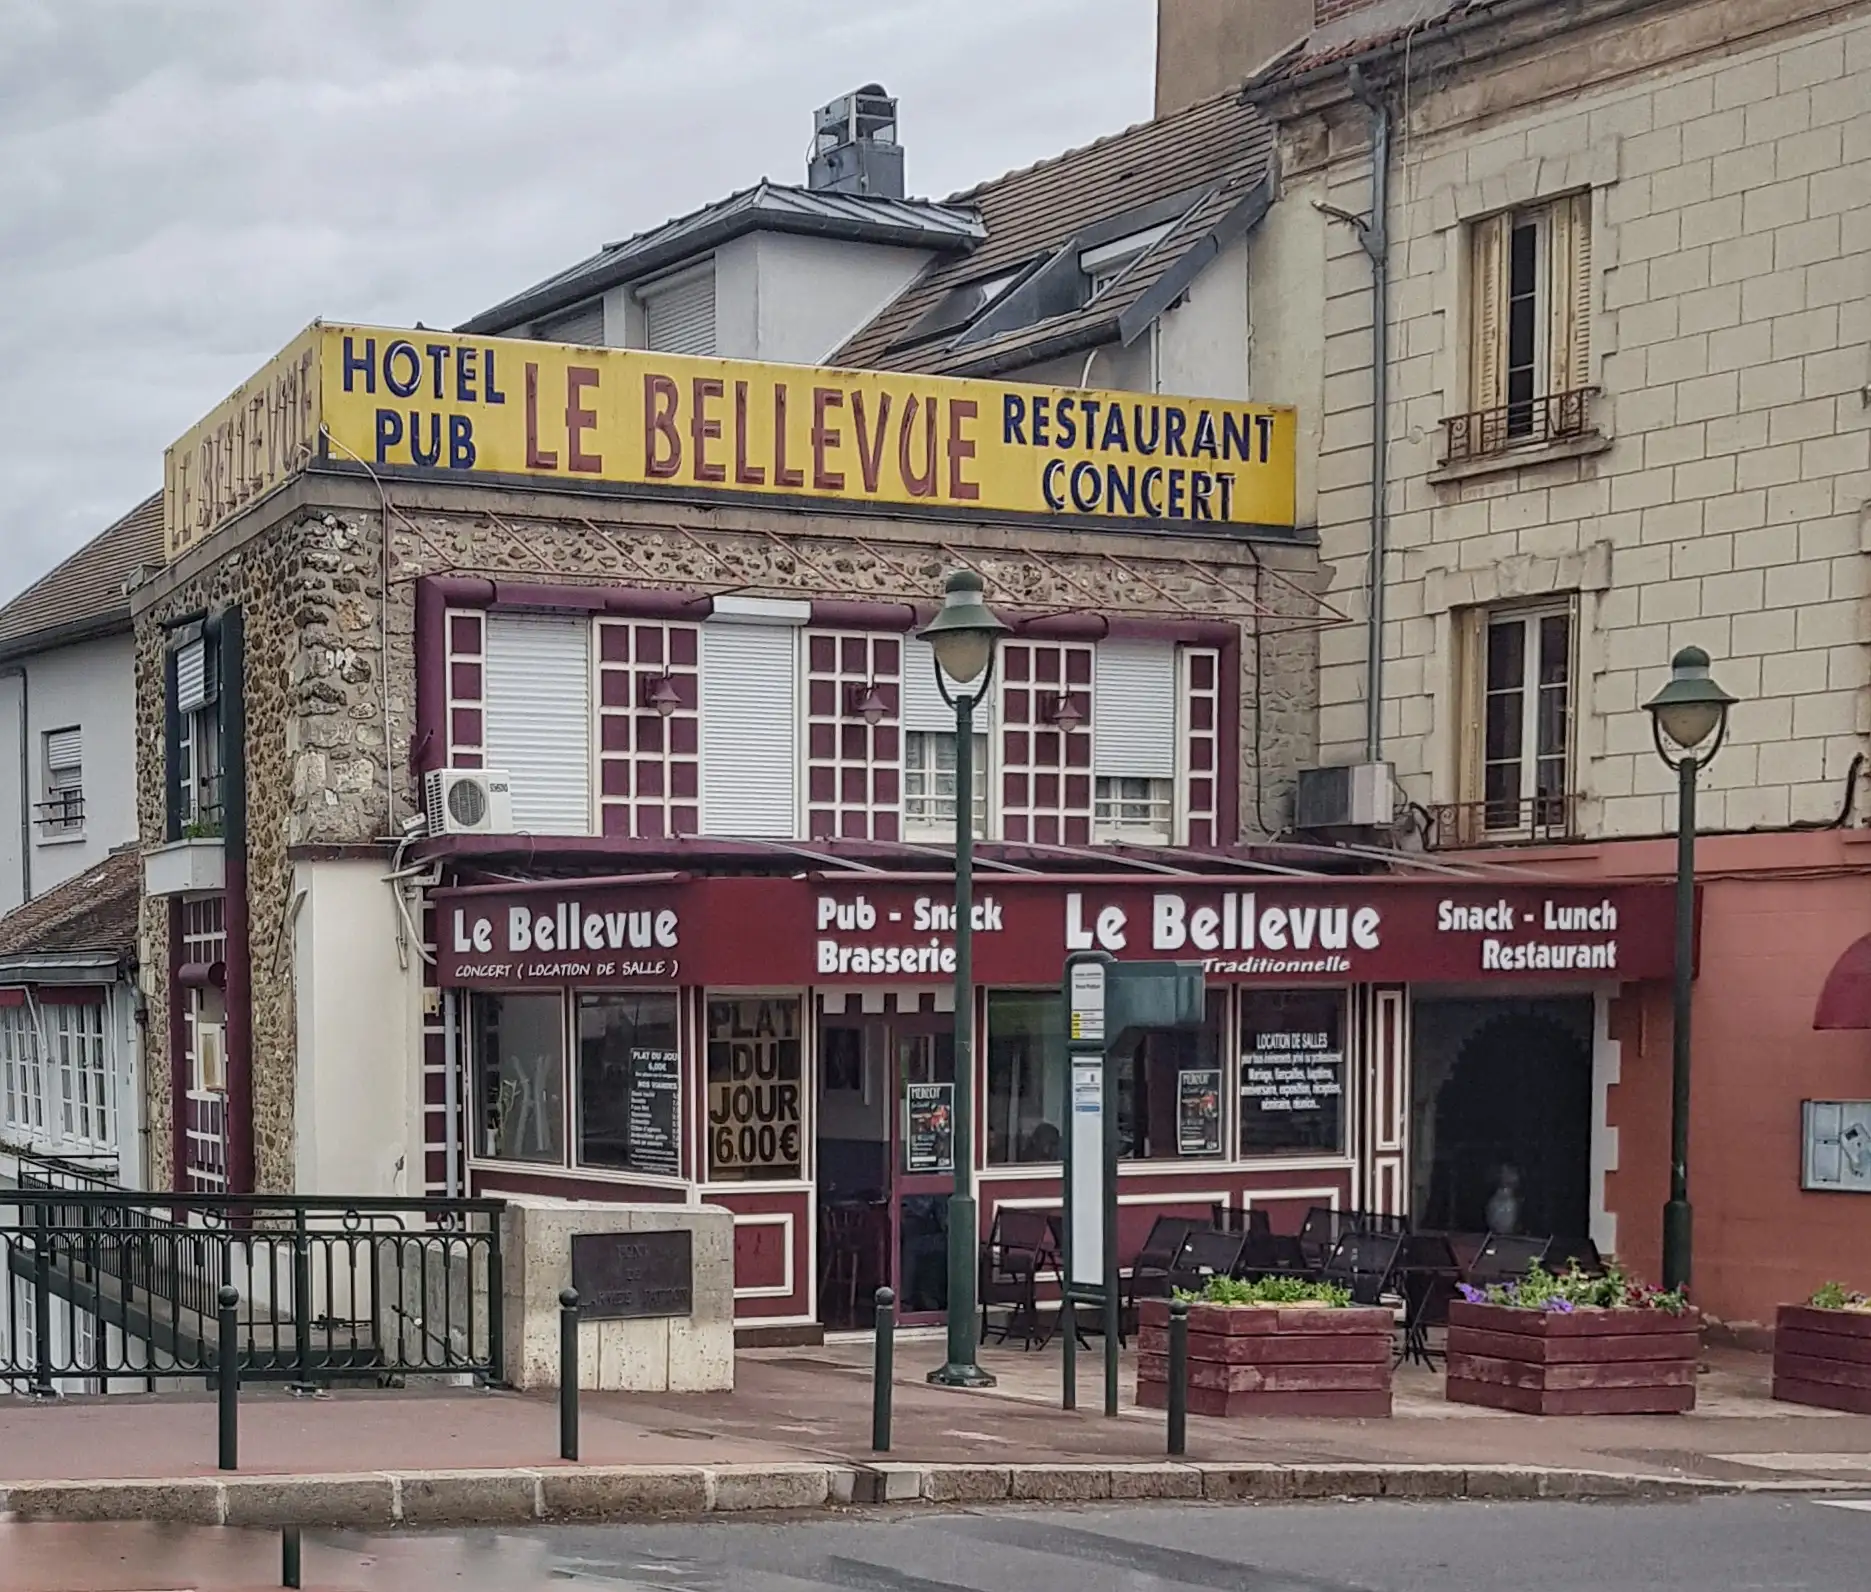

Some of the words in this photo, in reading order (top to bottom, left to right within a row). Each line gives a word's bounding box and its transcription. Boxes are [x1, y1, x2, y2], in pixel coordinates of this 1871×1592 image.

[343, 336, 505, 404] HOTEL
[375, 408, 477, 470] PUB
[525, 361, 604, 474] LE
[644, 372, 980, 501] BELLEVUE
[1003, 393, 1274, 463] RESTAURANT
[169, 450, 193, 552] LE
[197, 346, 314, 532] BELLEVUE
[1042, 457, 1236, 522] CONCERT
[454, 908, 493, 953] Le
[508, 902, 679, 953] Bellevue
[816, 895, 877, 931] Pub
[1066, 893, 1127, 950] Le
[1152, 893, 1382, 951] Bellevue
[1438, 899, 1514, 931] Snack
[1544, 899, 1617, 931] Lunch
[455, 963, 513, 978] CONCERT
[528, 962, 592, 977] LOCATION
[597, 961, 615, 976] DE
[622, 960, 667, 976] SALLE
[816, 937, 957, 974] Brasserie
[1202, 956, 1351, 974] Traditionnelle
[1482, 938, 1617, 970] Restaurant
[709, 999, 801, 1039] PLAT
[1256, 1033, 1290, 1049] LOCATION
[1291, 1033, 1301, 1049] DE
[1302, 1032, 1328, 1048] SALLES
[732, 1042, 778, 1081] DU
[709, 1084, 800, 1125] JOUR
